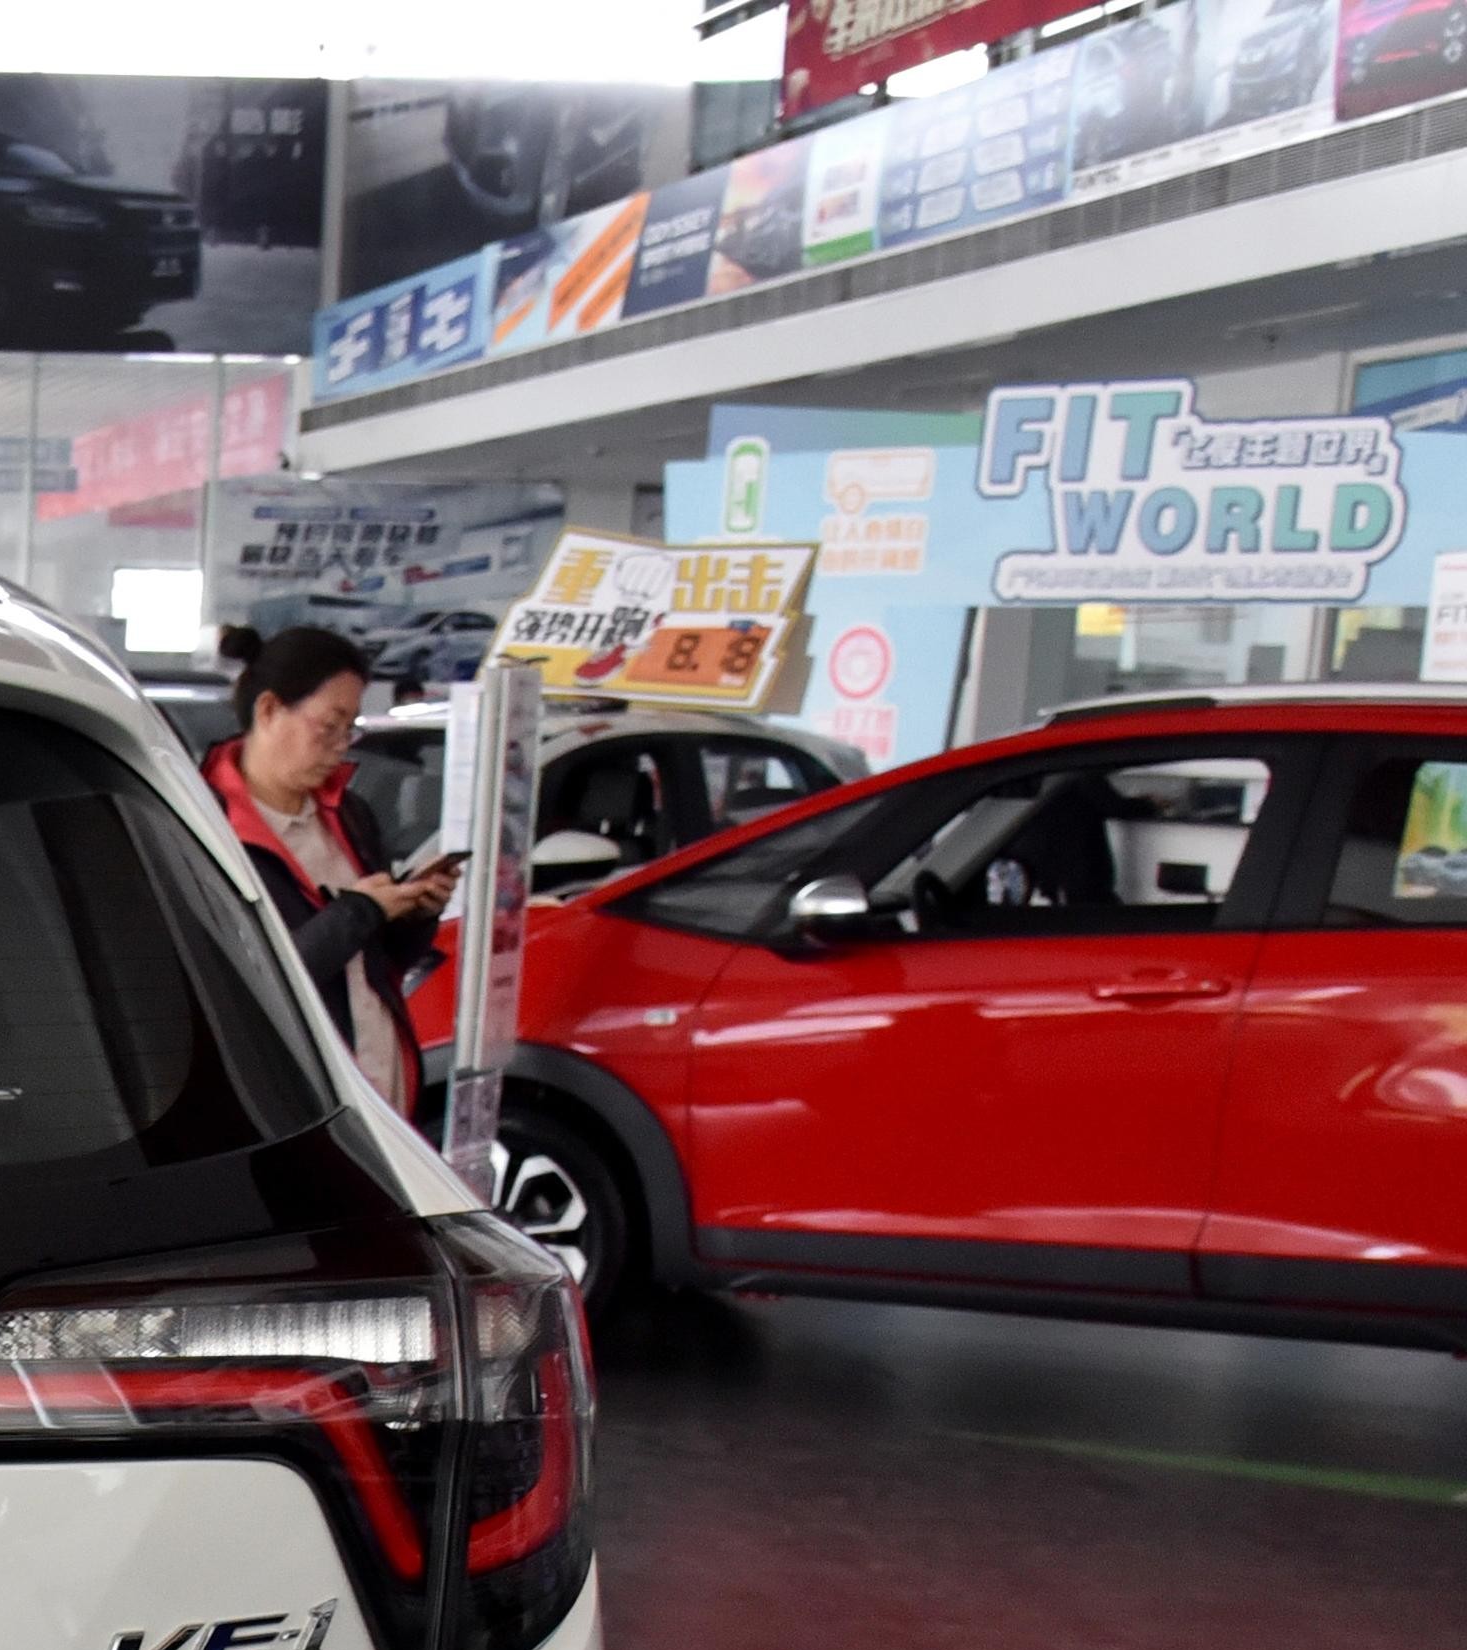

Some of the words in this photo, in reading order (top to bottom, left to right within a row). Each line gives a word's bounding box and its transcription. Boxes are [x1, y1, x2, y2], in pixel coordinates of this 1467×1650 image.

[988, 391, 1182, 484] FIT
[1061, 483, 1393, 556] WORLD
[671, 553, 784, 612] 出击
